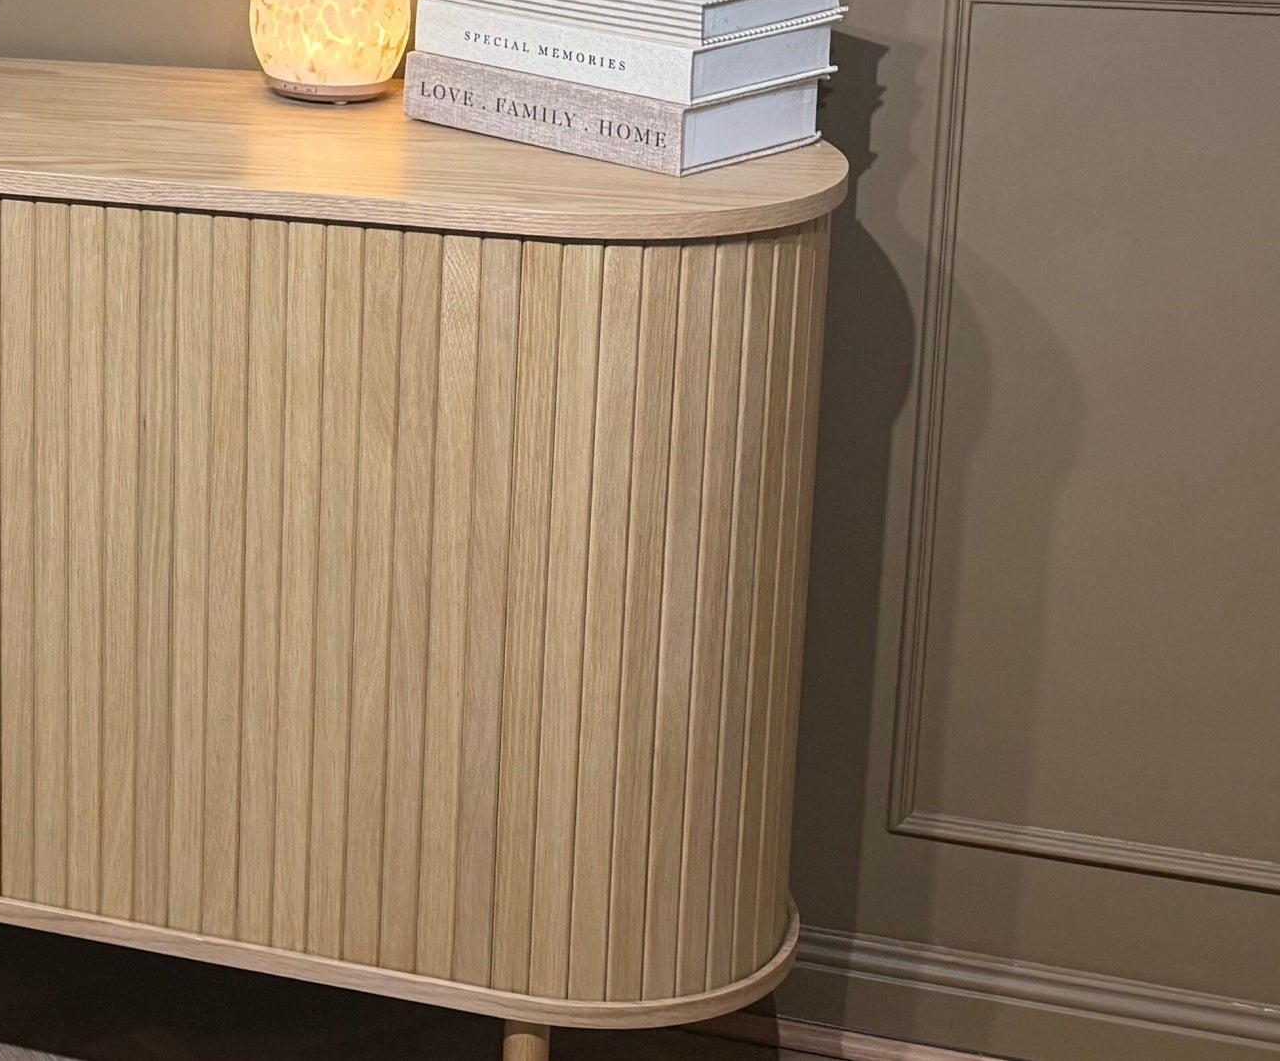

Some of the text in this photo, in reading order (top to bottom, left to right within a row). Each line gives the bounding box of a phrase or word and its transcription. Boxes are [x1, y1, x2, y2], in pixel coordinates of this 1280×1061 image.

[463, 31, 627, 71] SPECIAL MEMORIES
[421, 81, 474, 107] LOVE
[495, 97, 576, 128] FAMILY
[600, 119, 667, 148] HOME
